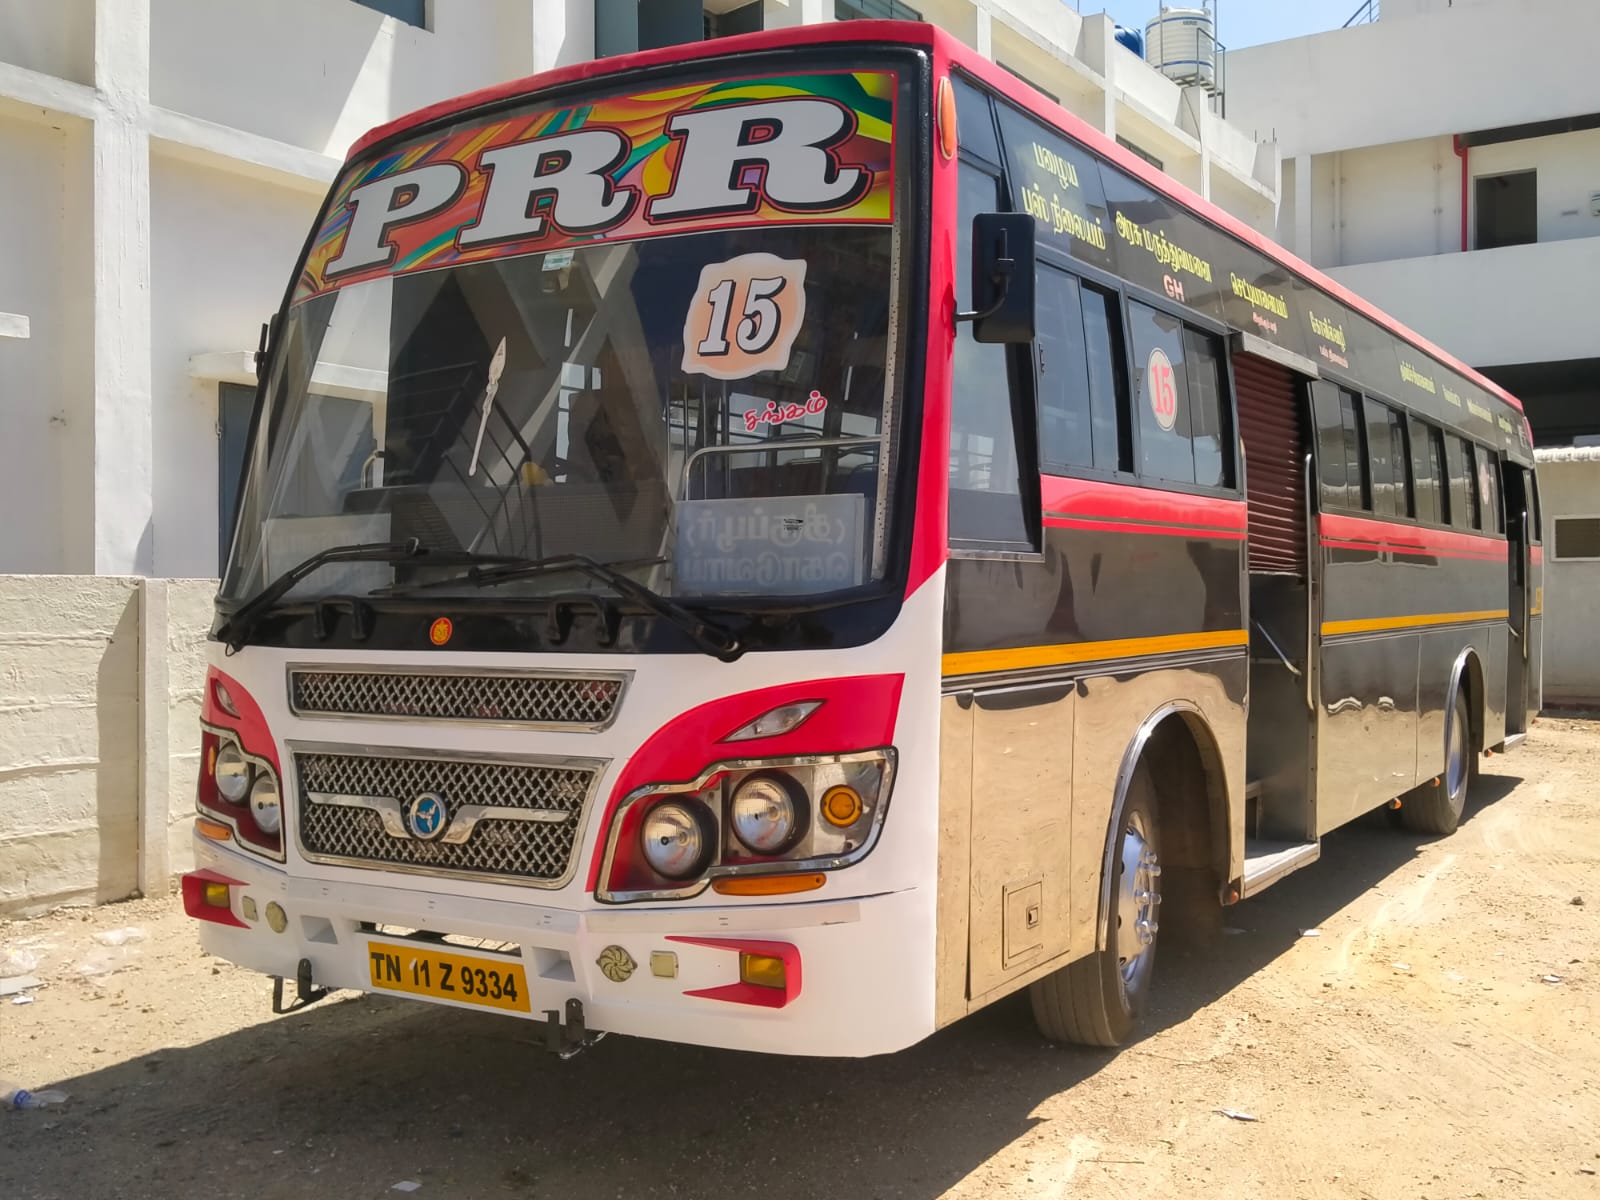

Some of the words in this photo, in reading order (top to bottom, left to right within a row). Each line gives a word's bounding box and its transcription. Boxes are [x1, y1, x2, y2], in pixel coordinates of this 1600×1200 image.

[322, 96, 876, 282] PRR
[1032, 142, 1079, 190] பழைய
[1021, 183, 1050, 223] பஸ்
[1050, 193, 1106, 250] நிலையம்
[1115, 210, 1143, 247] அரசு
[1142, 228, 1212, 283] மருத்துவமனை
[697, 276, 787, 357] 15
[1163, 274, 1185, 302] GH
[1151, 365, 1174, 416] 15
[371, 952, 402, 983] TN
[409, 958, 431, 988] 11
[439, 962, 455, 991] Z
[461, 966, 518, 1002] 9334
